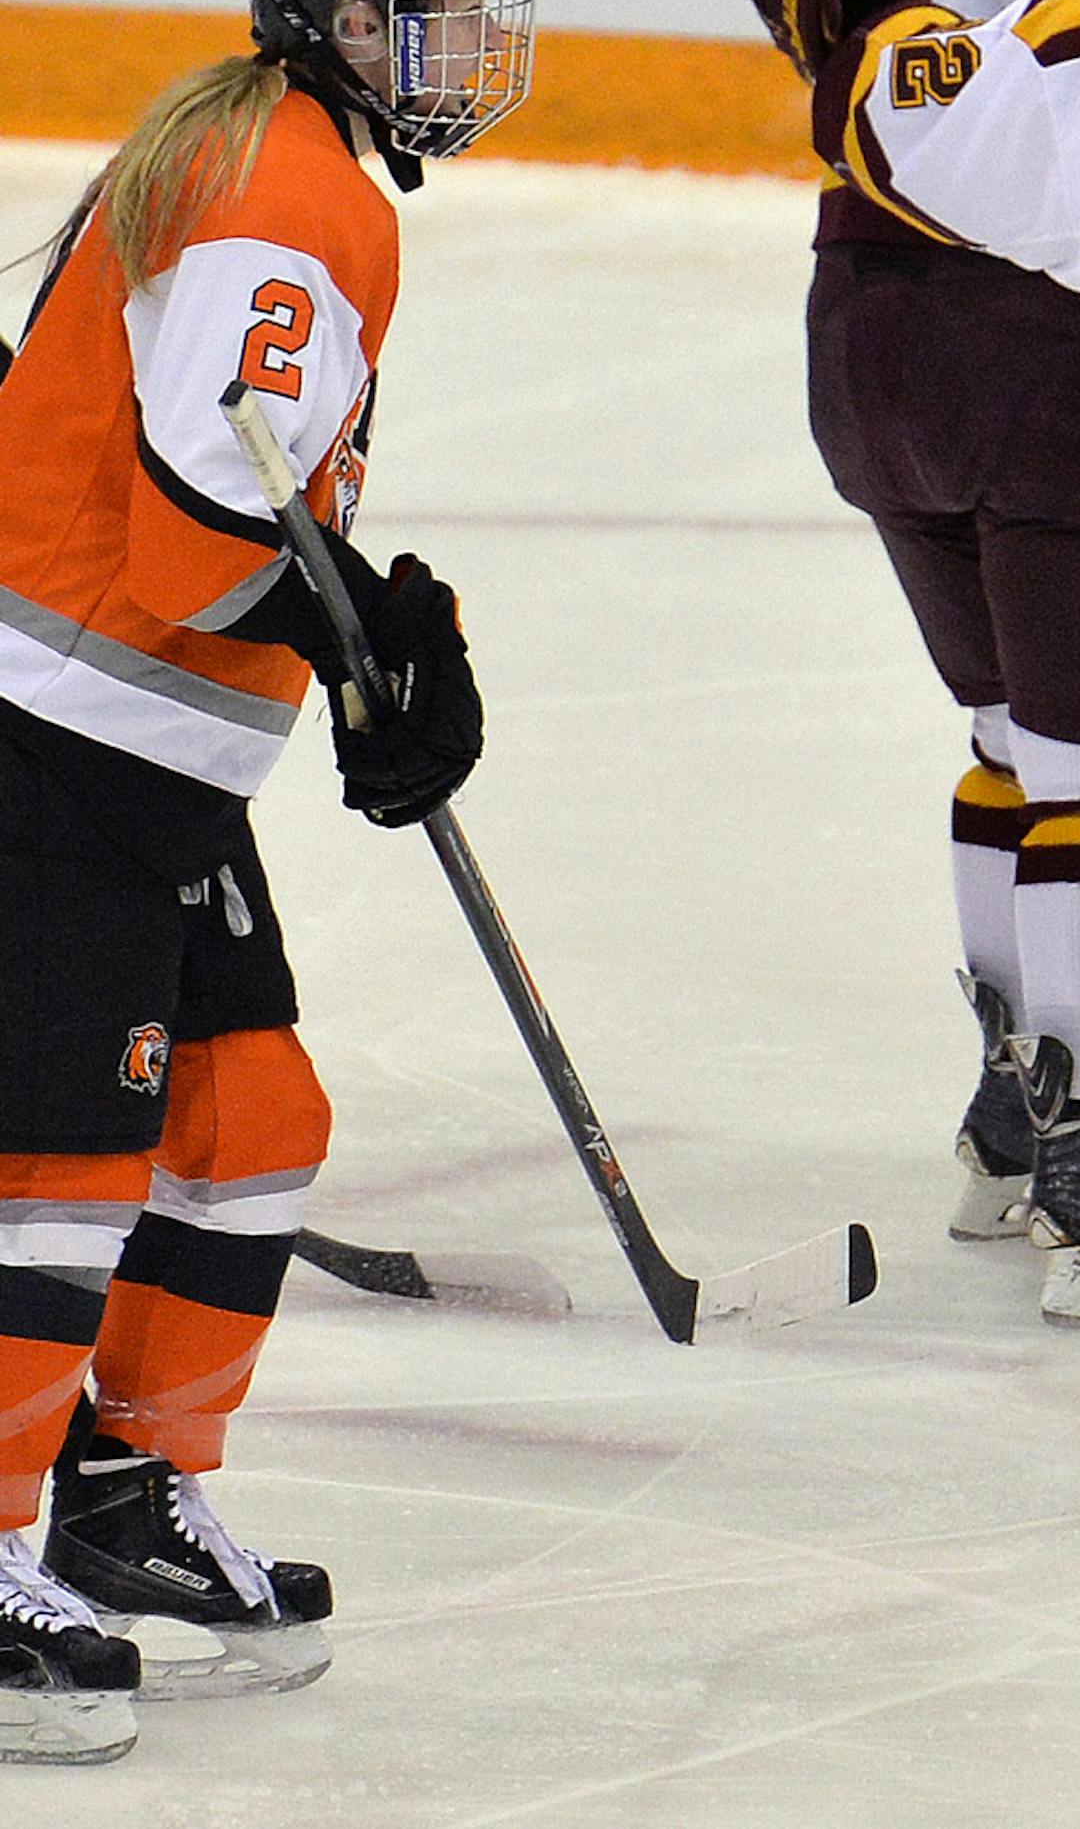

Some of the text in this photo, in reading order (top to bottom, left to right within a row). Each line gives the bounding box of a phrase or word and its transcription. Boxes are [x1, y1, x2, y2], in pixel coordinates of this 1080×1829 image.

[407, 19, 424, 91] BAUER
[235, 278, 315, 402] 2
[150, 1560, 206, 1589] BAUER
